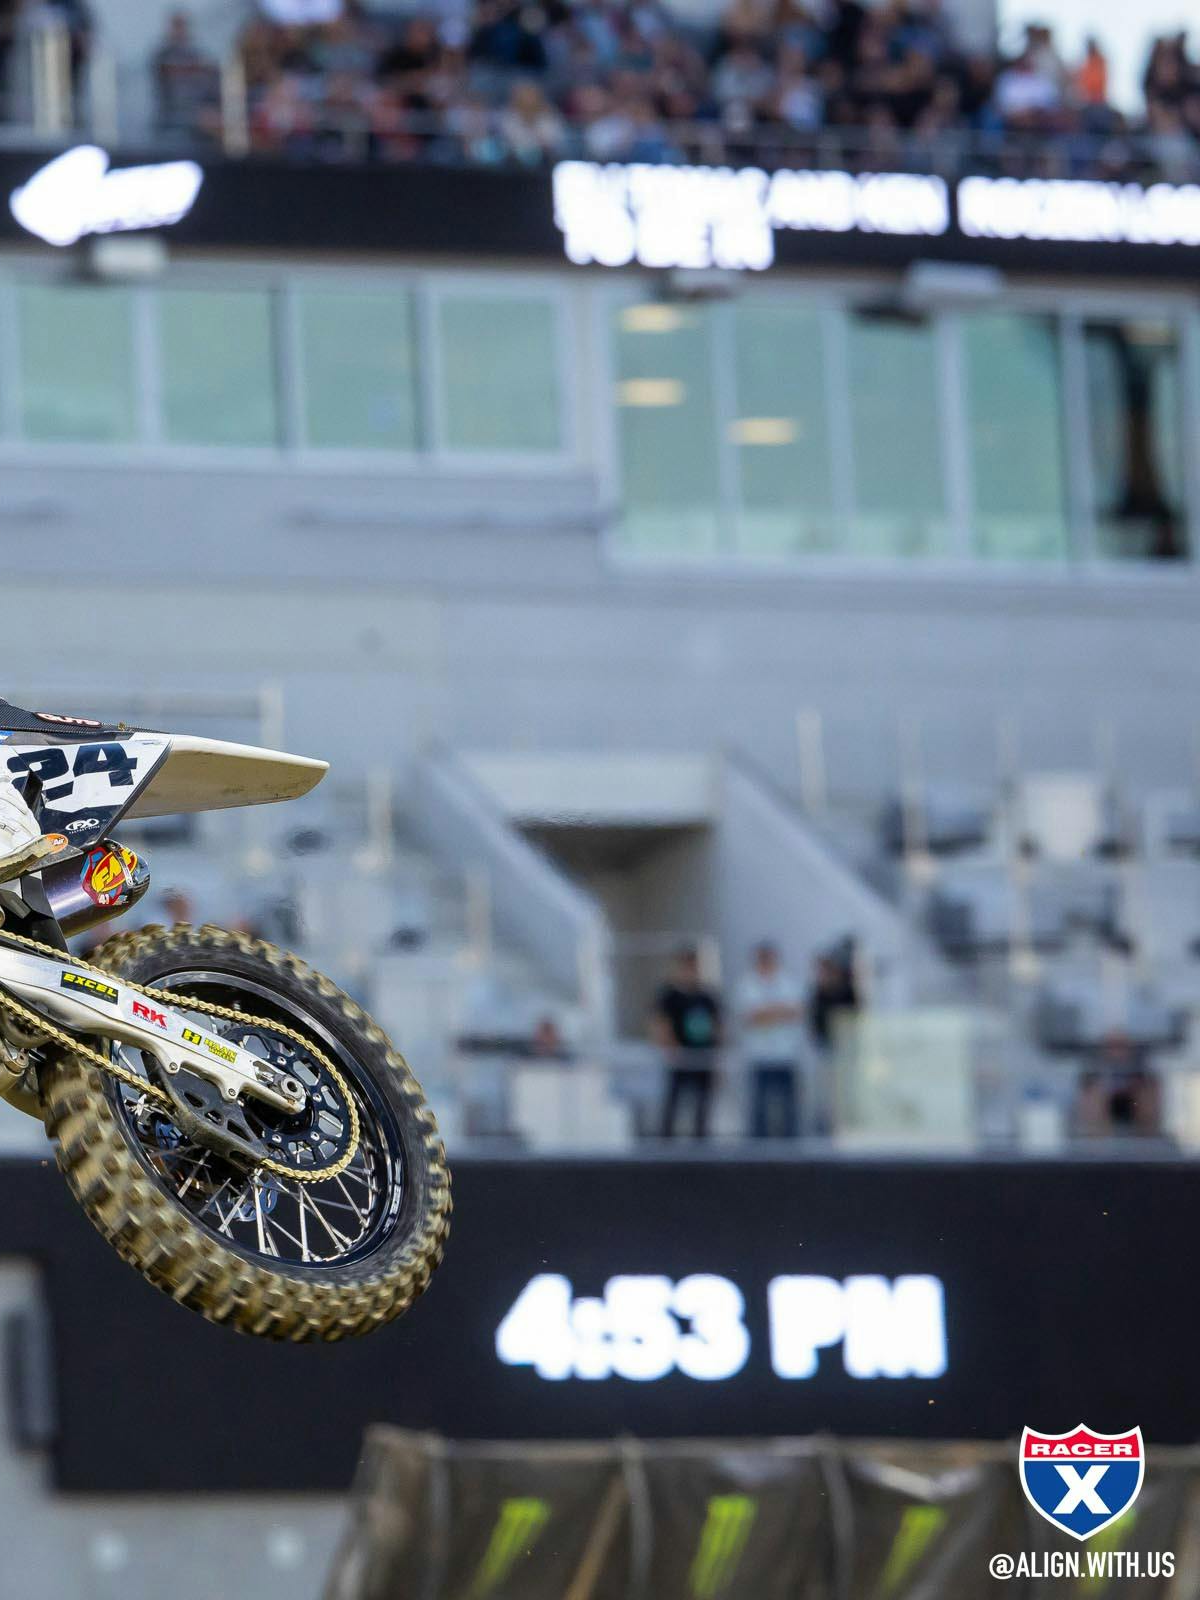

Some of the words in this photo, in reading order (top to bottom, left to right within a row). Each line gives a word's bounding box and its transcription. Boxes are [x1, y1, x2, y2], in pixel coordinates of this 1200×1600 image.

[7, 742, 138, 802] 24
[63, 972, 118, 998] EXCEL
[133, 1001, 167, 1028] RK
[496, 1272, 750, 1381] 4:53
[767, 1272, 949, 1380] PM
